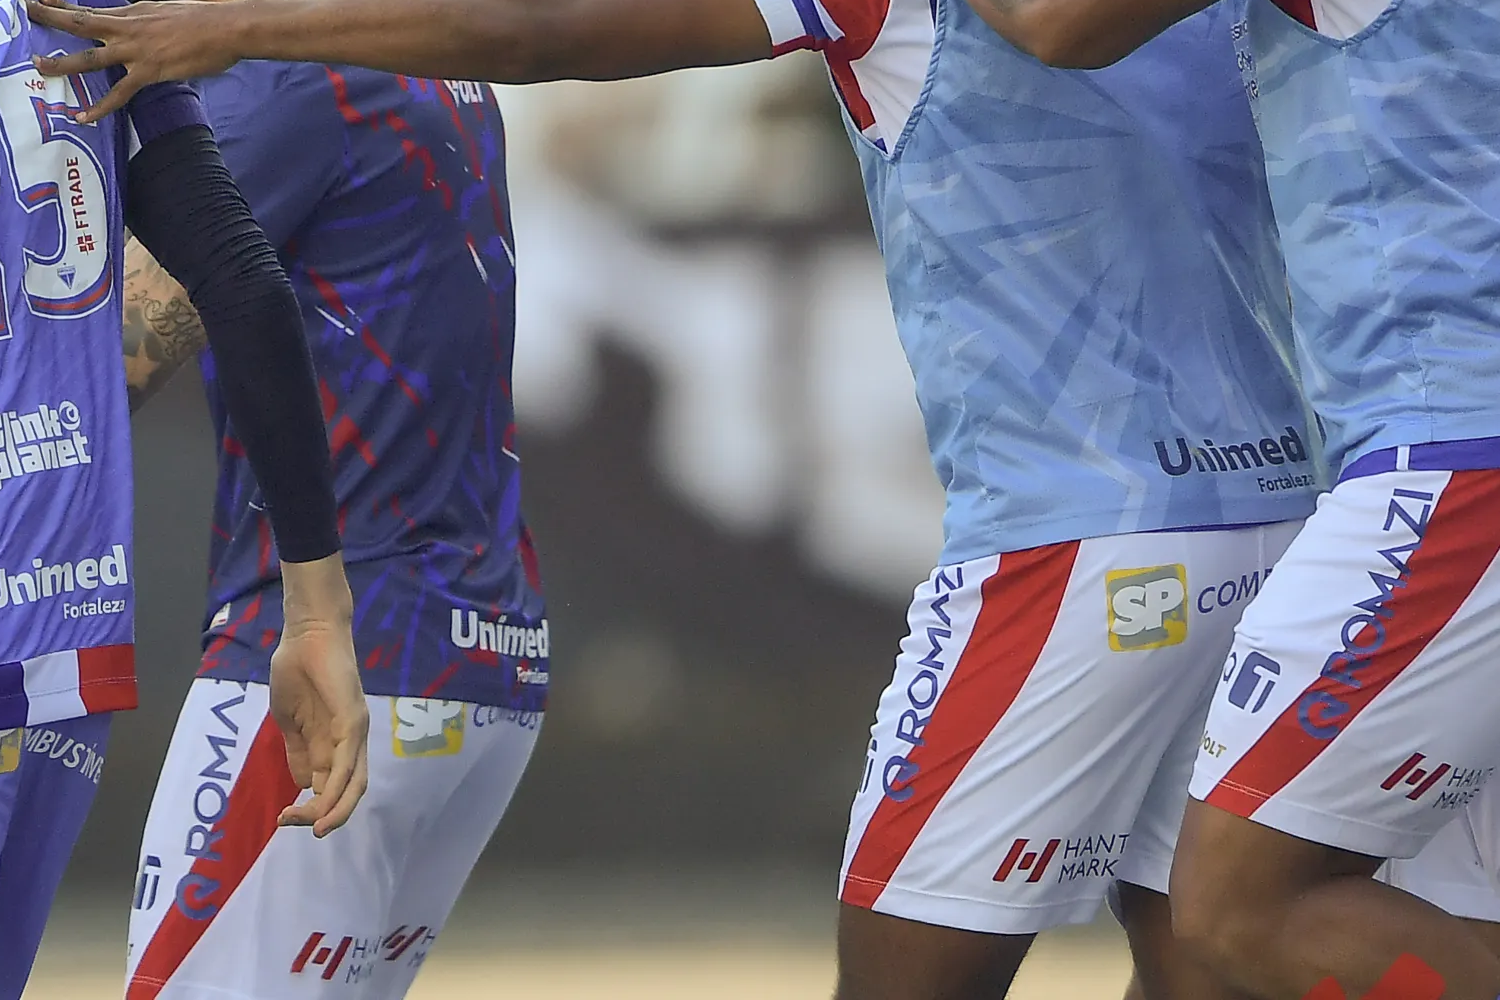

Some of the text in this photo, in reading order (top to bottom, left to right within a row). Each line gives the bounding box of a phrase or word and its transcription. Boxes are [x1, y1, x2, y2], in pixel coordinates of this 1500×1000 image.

[66, 156, 90, 229] FTRADE
[1154, 426, 1307, 476] Unimed
[63, 597, 126, 620] Fortaleza
[1110, 578, 1185, 636] SP
[451, 608, 549, 658] Unimed
[1058, 858, 1119, 884] MARK
